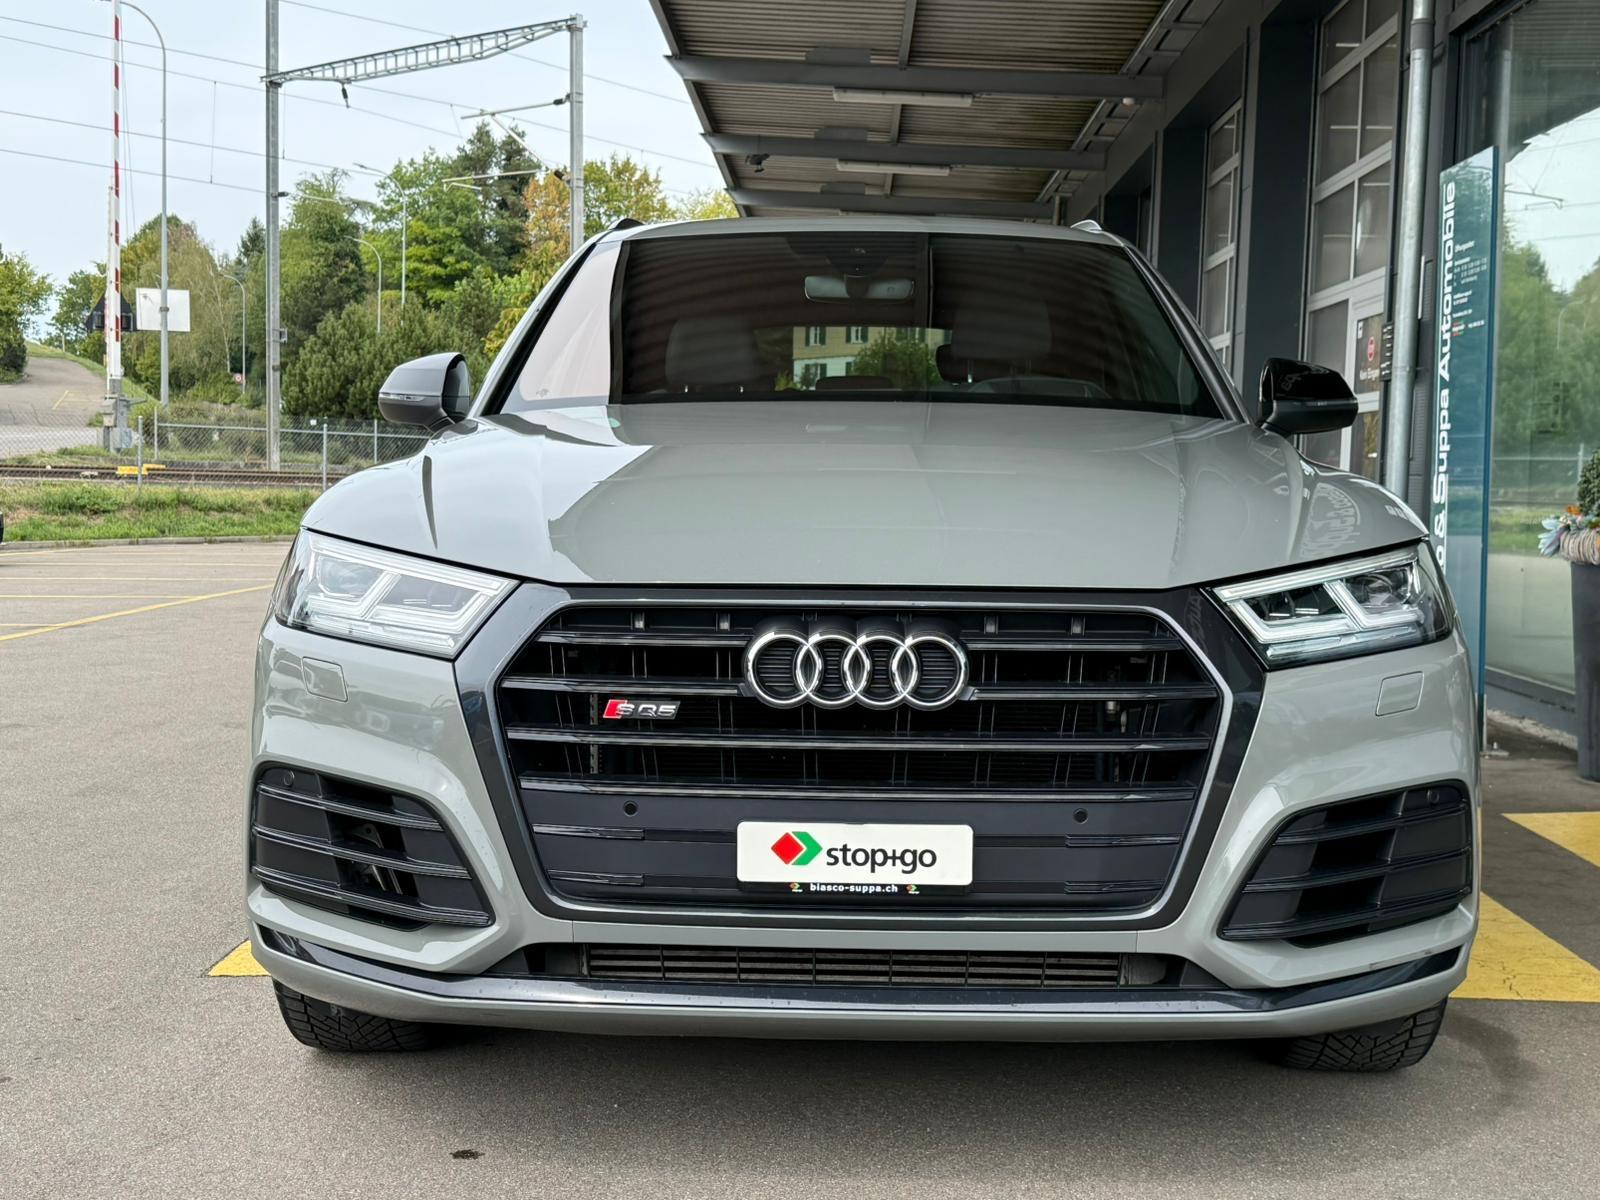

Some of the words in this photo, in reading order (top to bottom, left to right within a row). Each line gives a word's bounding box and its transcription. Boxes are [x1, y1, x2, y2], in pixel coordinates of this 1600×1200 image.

[1439, 181, 1455, 382] Automobile
[1433, 388, 1451, 504] Suppa
[1434, 510, 1446, 538] &
[826, 843, 937, 874] stop+go
